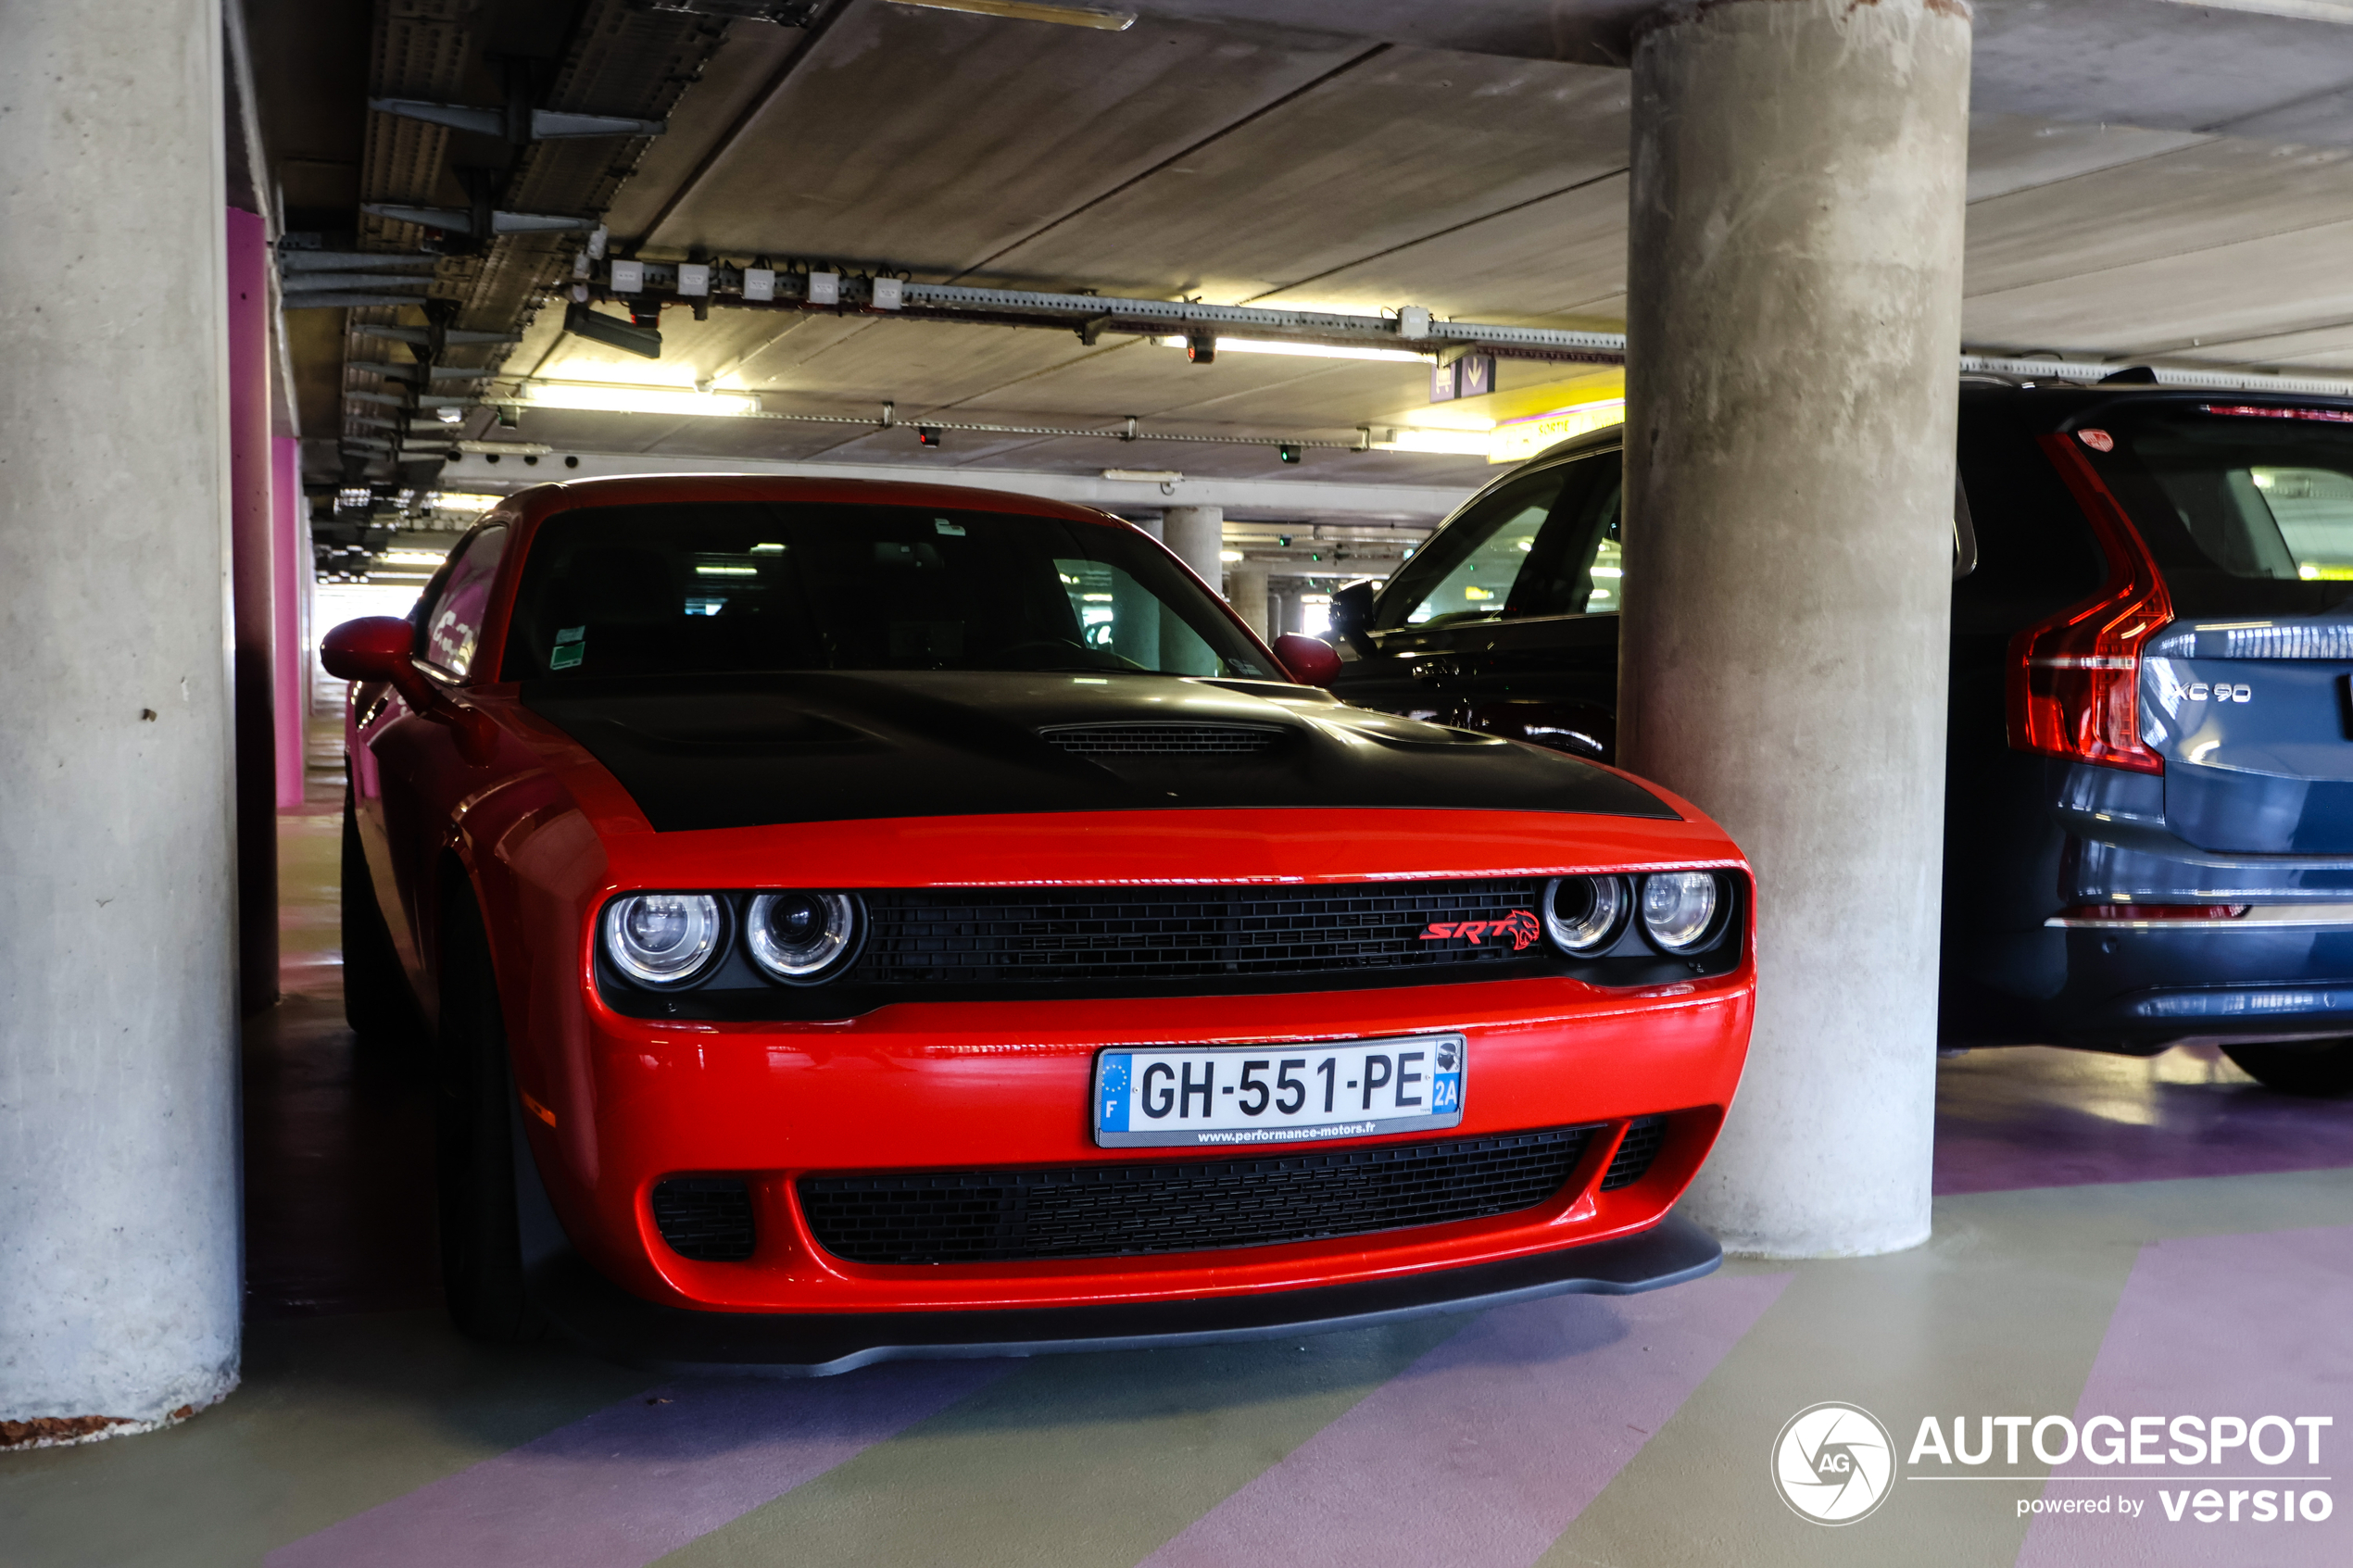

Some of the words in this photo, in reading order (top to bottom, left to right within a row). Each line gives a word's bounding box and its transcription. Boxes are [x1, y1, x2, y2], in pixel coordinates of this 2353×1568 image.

[1538, 420, 1569, 436] SORTIE
[1419, 920, 1517, 945] SRT
[1140, 1052, 1425, 1119] GH-551-PE
[1435, 1080, 1457, 1107] 2A
[1105, 1100, 1117, 1118] F
[1198, 1122, 1376, 1144] www.performance-motors.fr
